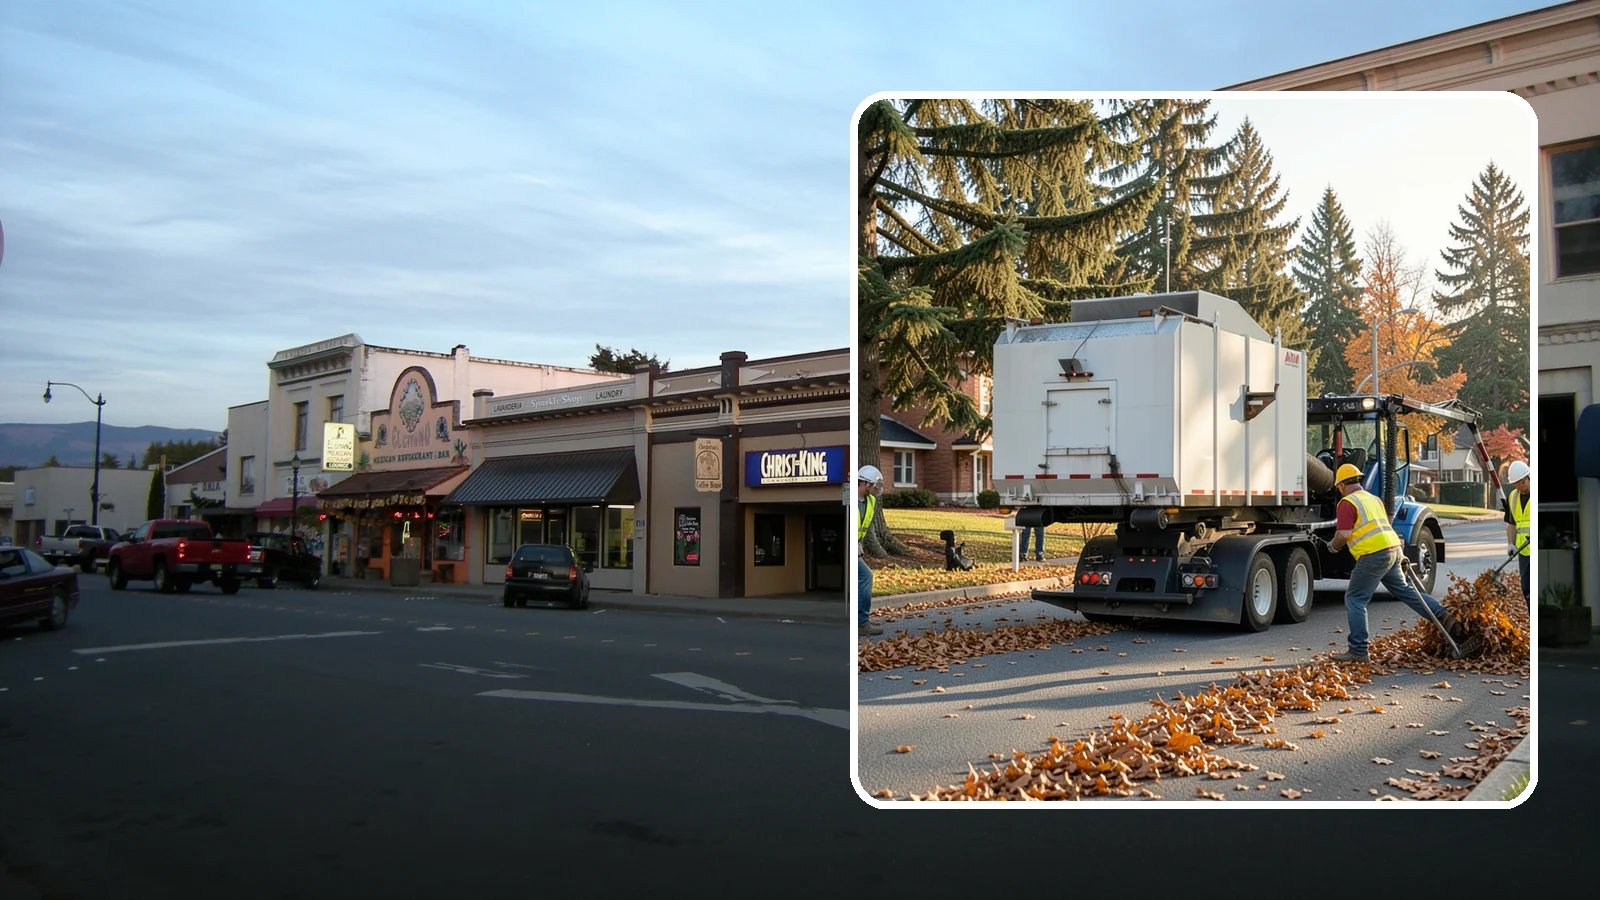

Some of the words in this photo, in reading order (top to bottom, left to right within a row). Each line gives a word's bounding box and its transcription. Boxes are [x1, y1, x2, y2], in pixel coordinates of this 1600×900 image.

[595, 389, 623, 399] LAUNDRY
[531, 396, 560, 409] Sparkle
[561, 394, 582, 405] Shop
[374, 454, 396, 464] MEXICAN
[397, 450, 434, 462] RESTAURANT
[437, 450, 450, 459] BAR
[761, 452, 797, 478] CHRIST
[799, 450, 827, 476] KING
